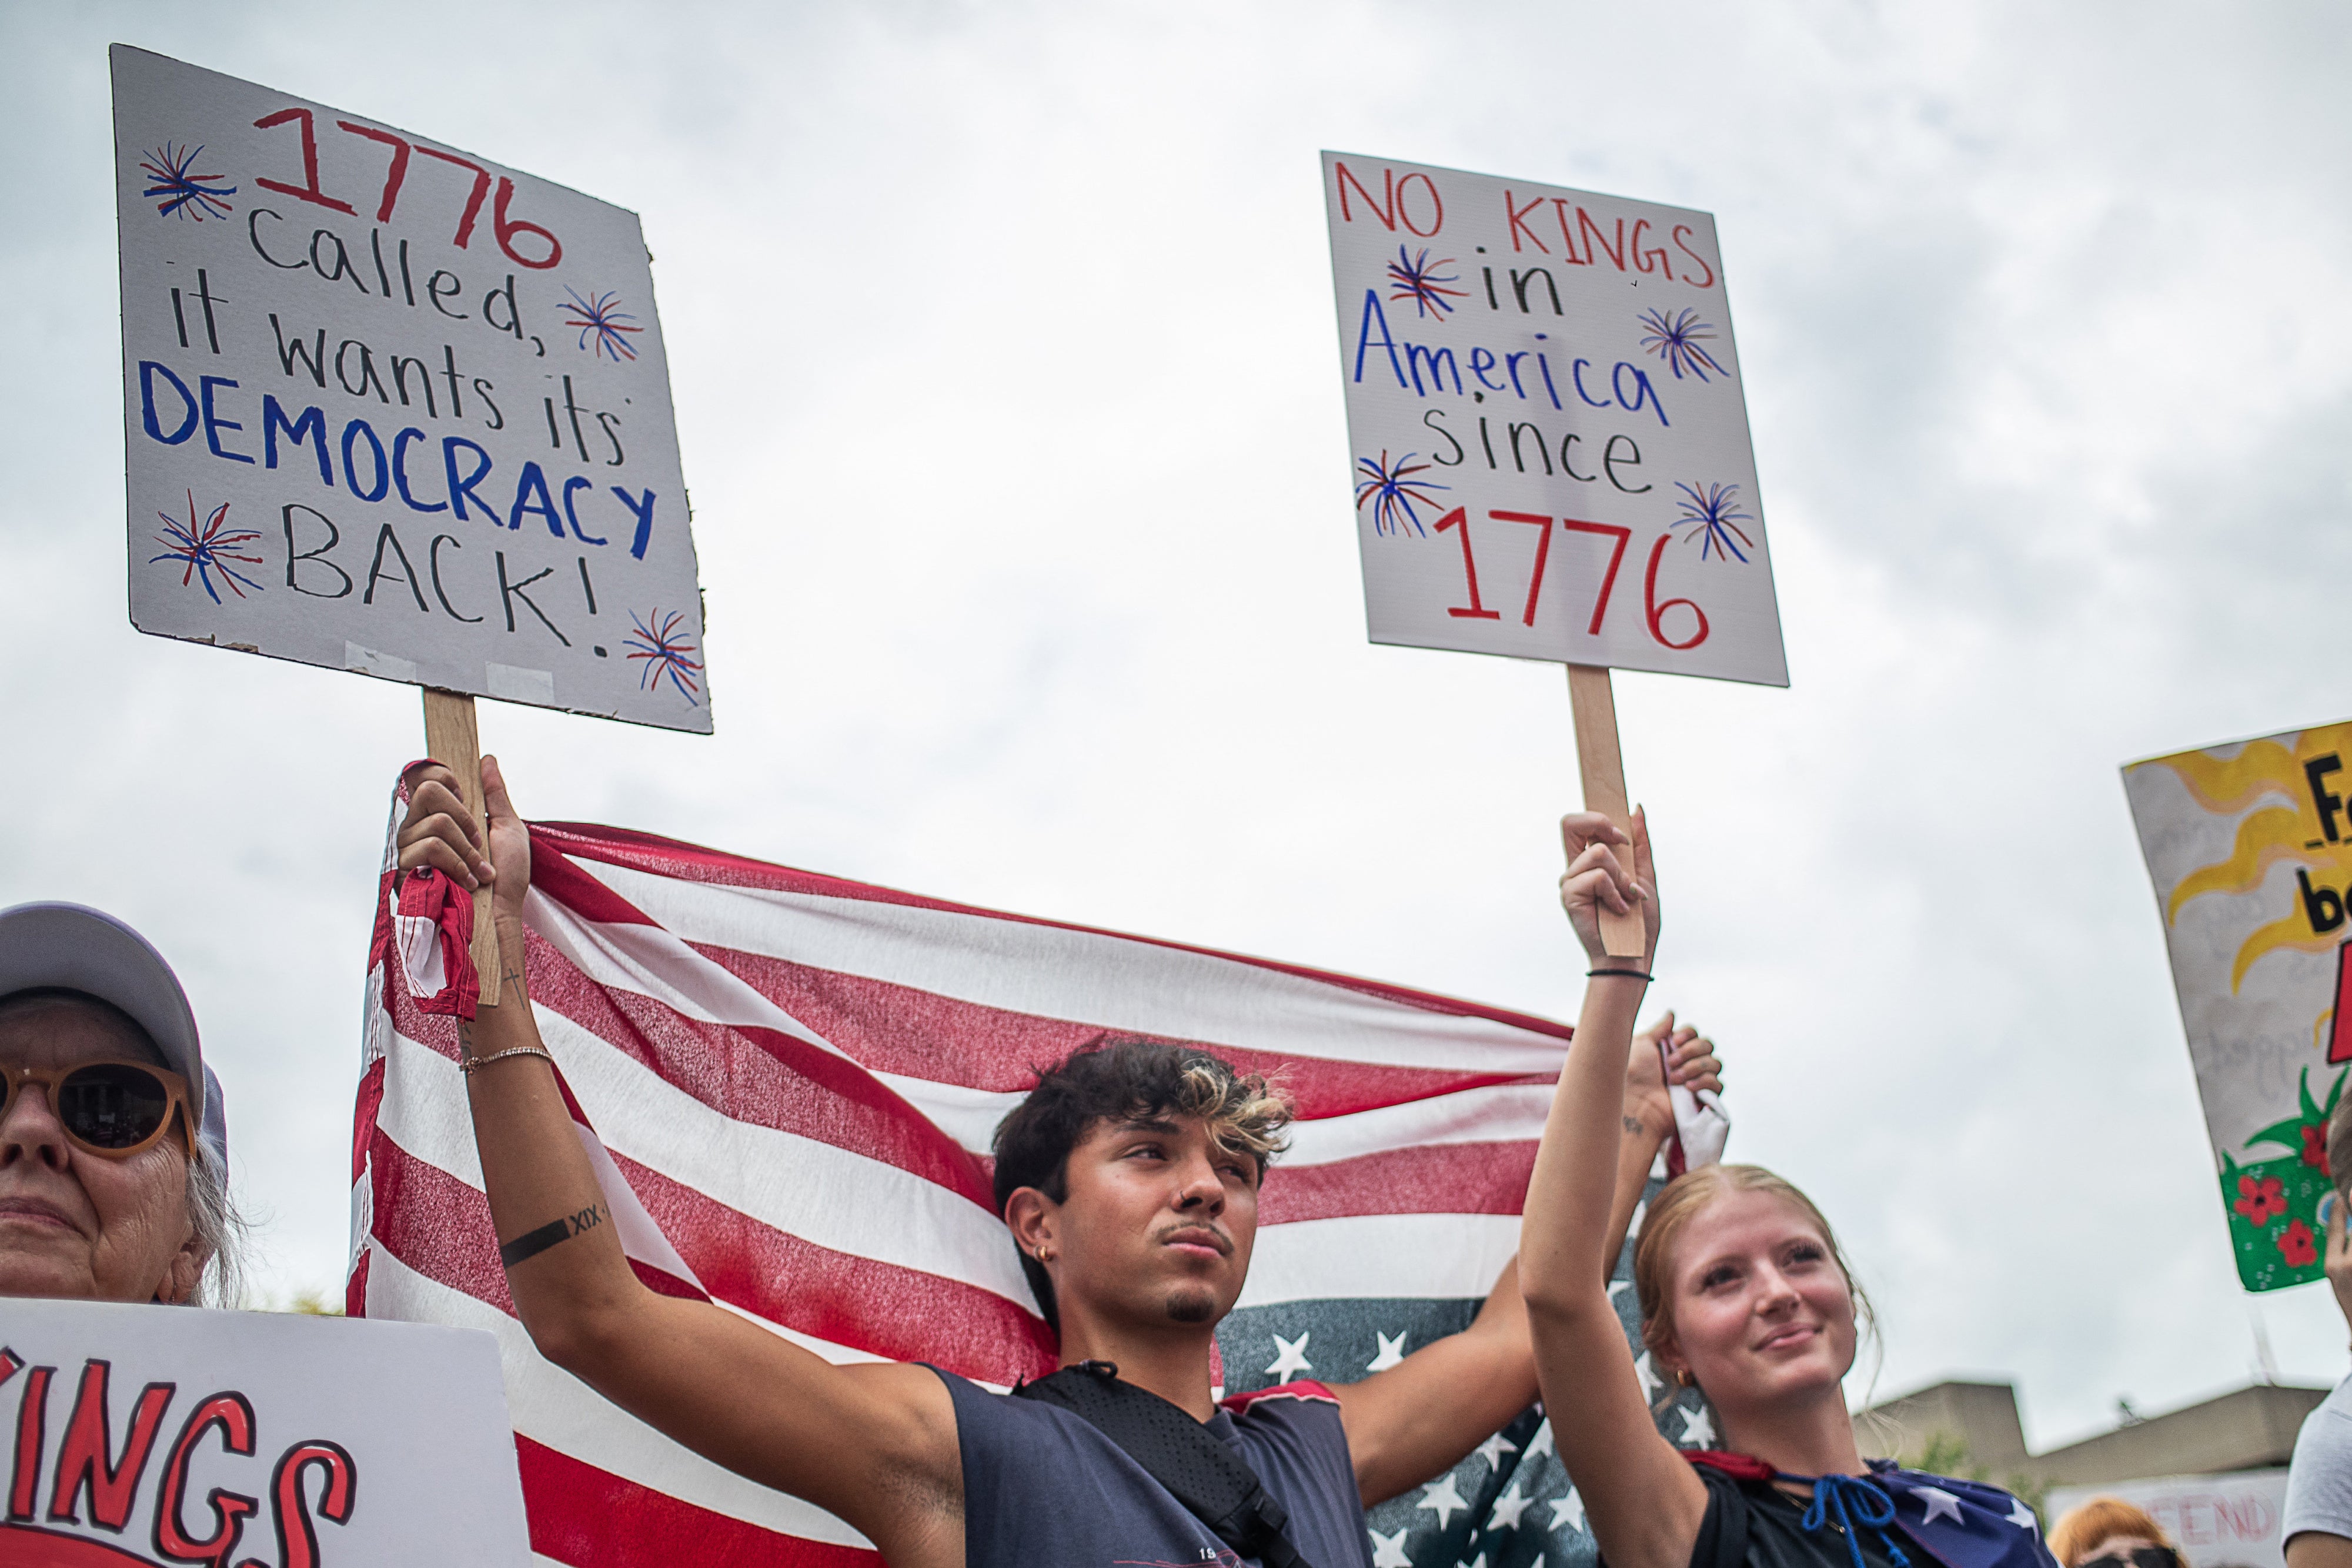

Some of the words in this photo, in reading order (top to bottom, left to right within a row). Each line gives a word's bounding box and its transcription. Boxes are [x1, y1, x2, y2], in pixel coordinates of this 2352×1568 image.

[253, 108, 562, 269] 1776
[1335, 162, 1444, 237] NO
[1505, 190, 1715, 289] KINGS
[166, 261, 228, 354] it
[269, 313, 504, 430] wants
[1476, 247, 1563, 316] in
[1354, 289, 1670, 427] America
[139, 360, 657, 560] DEMOCRACY
[1424, 392, 1652, 494] since
[282, 504, 608, 658] BACK!
[1434, 507, 1709, 650] 1776
[0, 1346, 358, 1568] INGS
